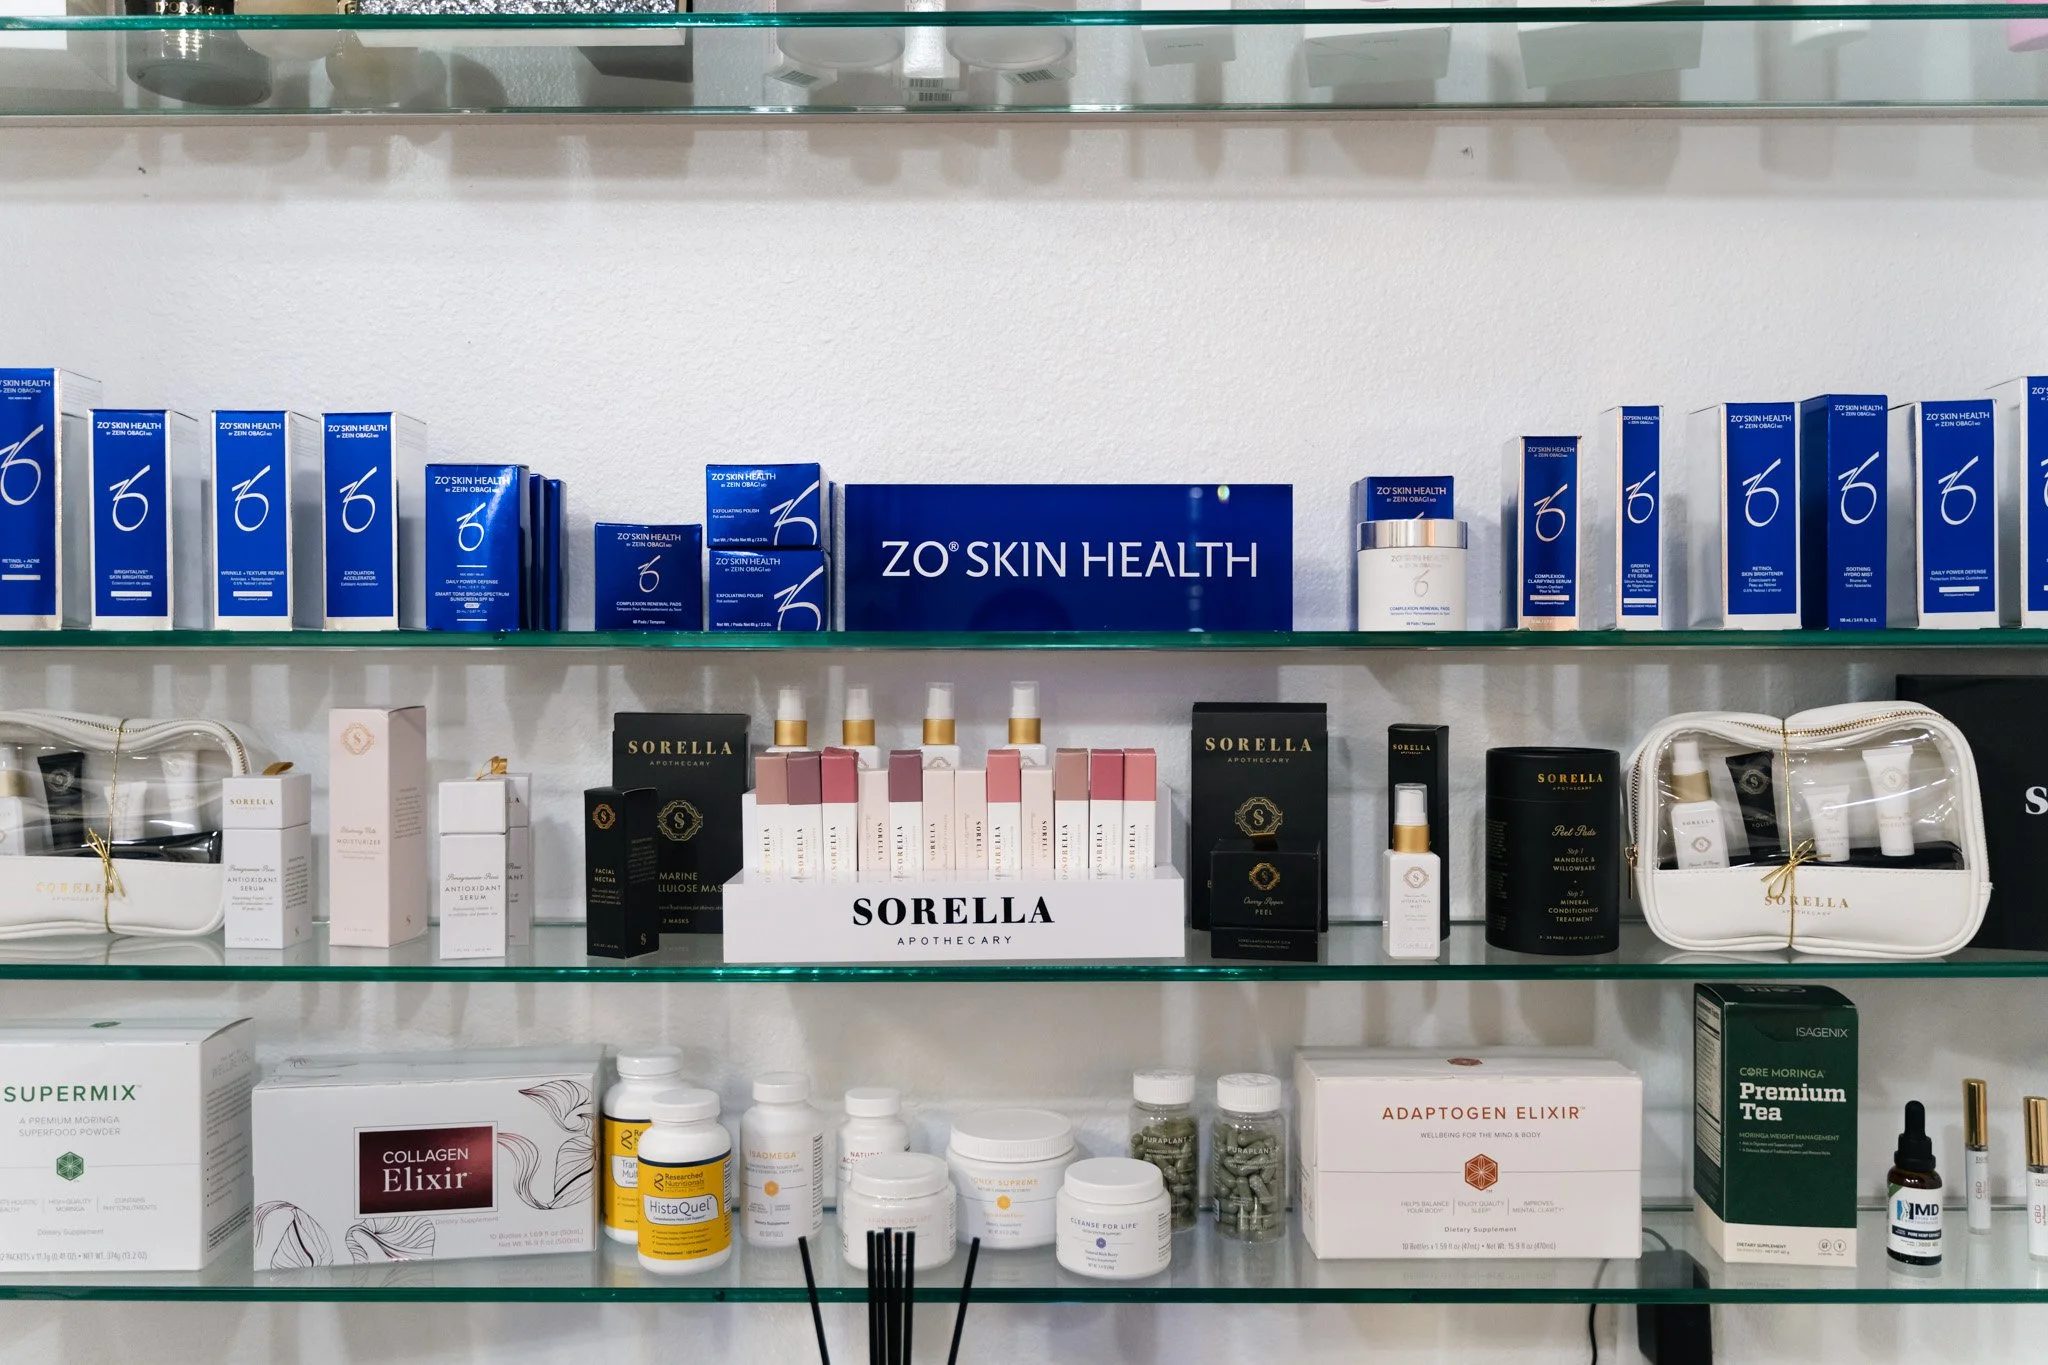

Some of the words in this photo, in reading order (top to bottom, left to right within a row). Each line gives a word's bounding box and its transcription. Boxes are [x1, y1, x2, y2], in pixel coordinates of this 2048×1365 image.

[2, 379, 23, 387] SKIN
[24, 379, 51, 387] HEALTH
[1744, 415, 1762, 423] SKIN
[1763, 414, 1792, 422] HEALTH
[1940, 413, 1958, 421] SKIN
[1959, 412, 1990, 420] HEALTH
[111, 421, 130, 429] SKIN
[130, 422, 162, 430] HEALTH
[233, 422, 251, 430] SKIN
[251, 422, 281, 430] HEALTH
[452, 476, 473, 485] SKIN
[474, 476, 510, 485] HEALTH
[726, 473, 744, 481] SKIN
[745, 473, 776, 481] HEALTH
[1392, 487, 1412, 495] SKIN
[1413, 487, 1446, 495] HEALTH
[631, 533, 649, 541] SKIN
[650, 533, 681, 541] HEALTH
[965, 540, 1066, 578] SKIN
[1081, 541, 1257, 578] HEALTH
[628, 740, 733, 754] SORELLA
[1205, 737, 1312, 752] SORELLA
[1537, 773, 1603, 783] SORELLA
[1551, 825, 1574, 837] Peel
[1574, 825, 1597, 836] Pads
[659, 872, 698, 880] MARINE
[1243, 897, 1263, 906] Cherry
[1263, 897, 1284, 906] Pepper
[1764, 894, 1849, 909] SORELLA
[853, 896, 1056, 926] SORELLA
[897, 935, 1012, 945] APOTHECARY
[1796, 1027, 1848, 1038] ISAGENIX
[1739, 1067, 1768, 1077] CORE
[1771, 1068, 1824, 1079] MORINGA
[4, 1085, 136, 1102] SUPERMIX
[1739, 1082, 1847, 1102] Premium
[1381, 1106, 1507, 1120] ADAPTOGEN
[1516, 1106, 1580, 1119] ELIXIR
[1739, 1102, 1782, 1121] Tea
[75, 1116, 120, 1124] MORINGA
[19, 1128, 77, 1137] SUPERFOOD
[80, 1128, 121, 1136] POWDER
[1143, 1135, 1187, 1144] PURAPLANT
[1227, 1145, 1272, 1155] PURAPLANT
[382, 1148, 469, 1164] COLLAGEN
[382, 1166, 468, 1193] Elixir
[665, 1171, 704, 1180] Researched
[665, 1178, 704, 1186] Nutritionals
[998, 1178, 1039, 1186] SUPREME
[649, 1197, 710, 1215] HistaQuel
[460, 1215, 499, 1225] Supplement
[1070, 1218, 1100, 1228] CLEANSE
[37, 1229, 61, 1237] Dietary
[63, 1228, 104, 1237] Supplement
[1473, 1225, 1517, 1233] Supplement
[1410, 1242, 1430, 1250] Bottles
